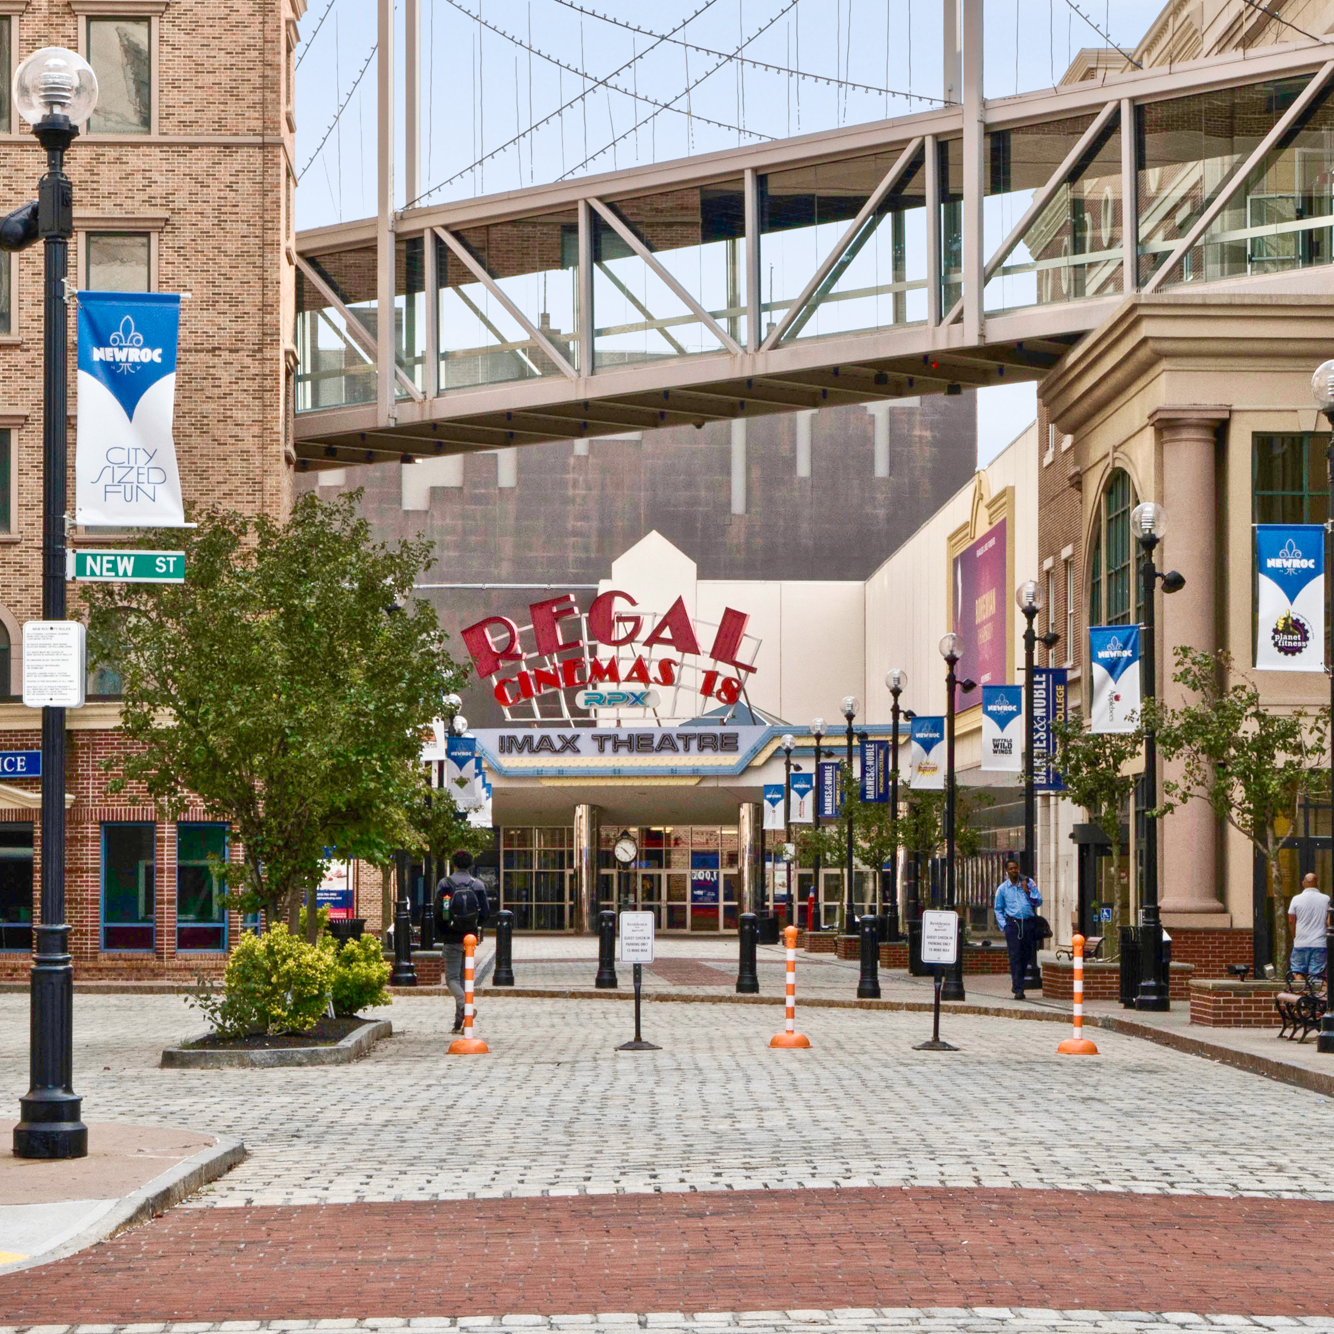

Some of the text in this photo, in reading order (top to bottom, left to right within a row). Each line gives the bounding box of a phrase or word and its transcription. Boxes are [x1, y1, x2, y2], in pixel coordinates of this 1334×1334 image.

[93, 346, 163, 364] NEWROC
[105, 446, 158, 466] CITY
[90, 465, 167, 485] SIZED
[103, 484, 156, 503] FUN
[85, 555, 177, 577] NEW ST
[1267, 558, 1315, 569] NEWROC
[461, 590, 757, 679] REGAL
[1274, 633, 1302, 642] planet
[1278, 639, 1307, 647] fitness
[1098, 649, 1133, 659] NEWROC
[494, 654, 743, 707] CINEMAS 18
[583, 690, 651, 708] RPX
[498, 731, 740, 754] IMAX THEATRE
